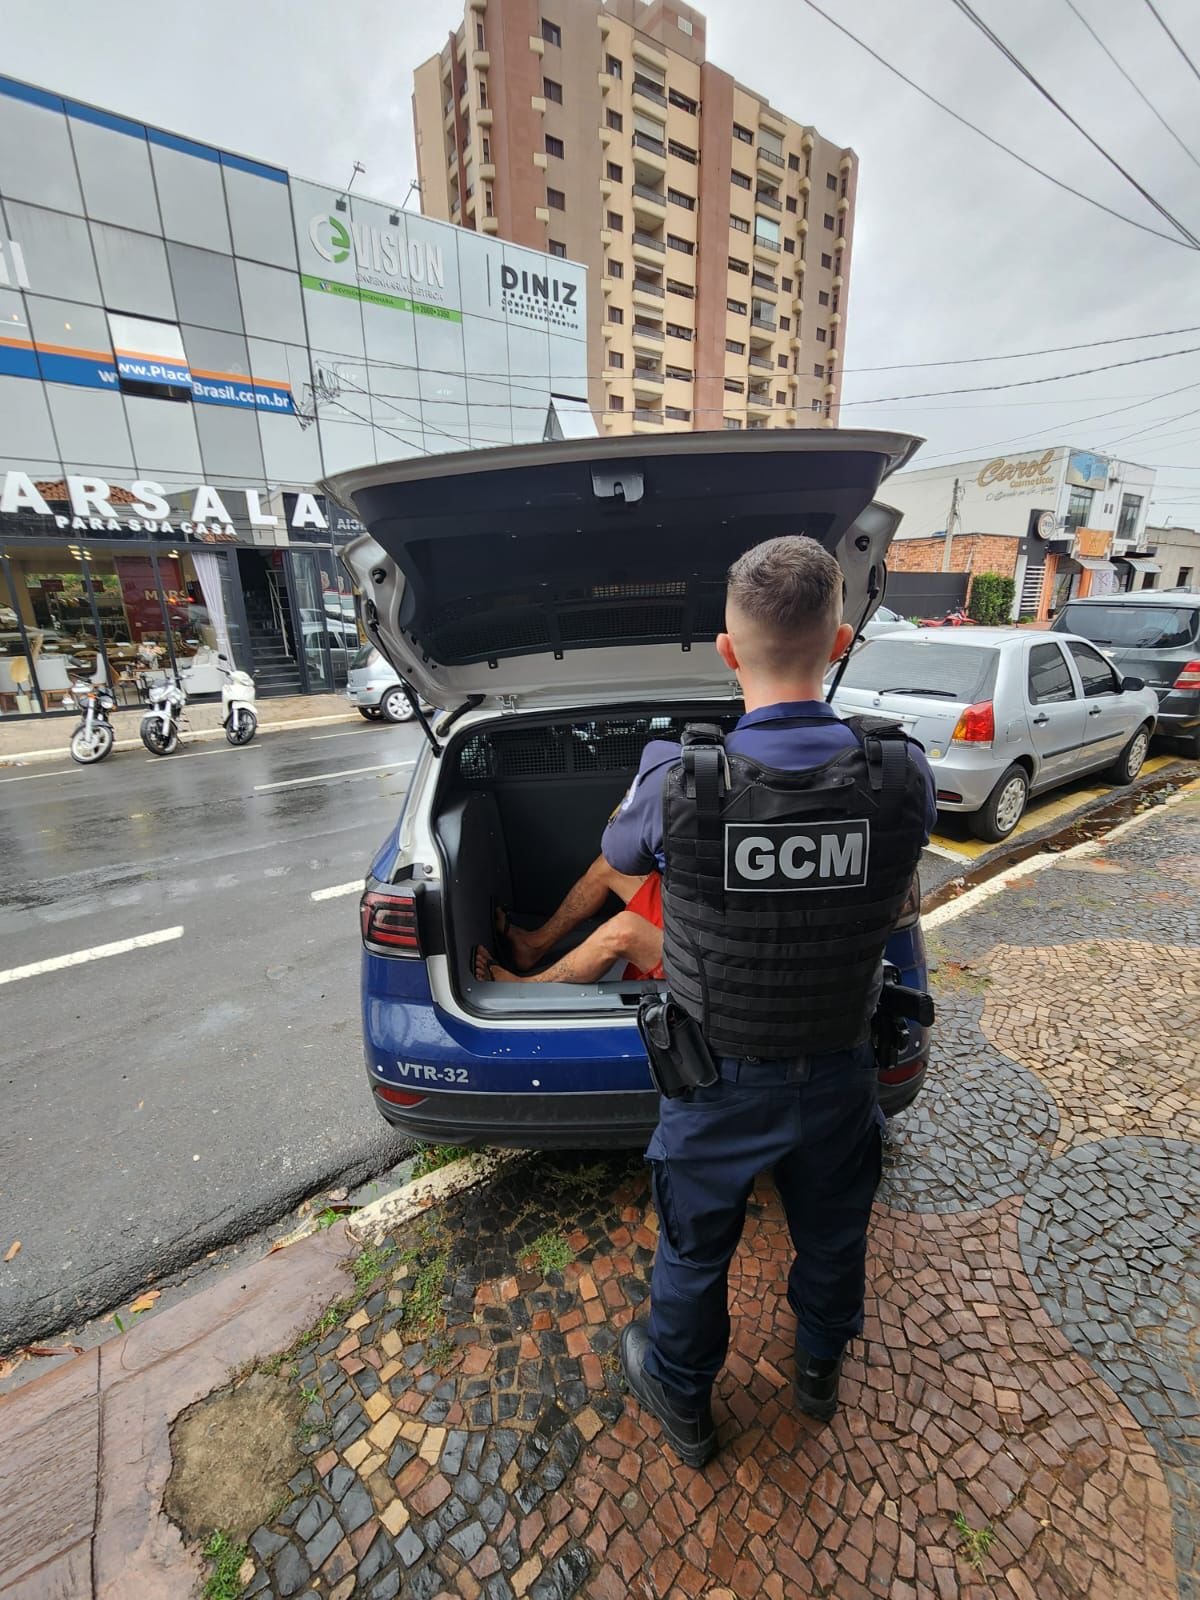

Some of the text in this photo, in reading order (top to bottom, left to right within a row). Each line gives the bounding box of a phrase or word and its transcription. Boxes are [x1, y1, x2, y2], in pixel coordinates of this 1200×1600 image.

[501, 264, 577, 306] DINIZ
[976, 449, 1056, 487] Carol
[55, 515, 238, 536] PARA SUA CASA
[734, 832, 864, 881] GCM
[396, 1061, 469, 1083] VTR-32
